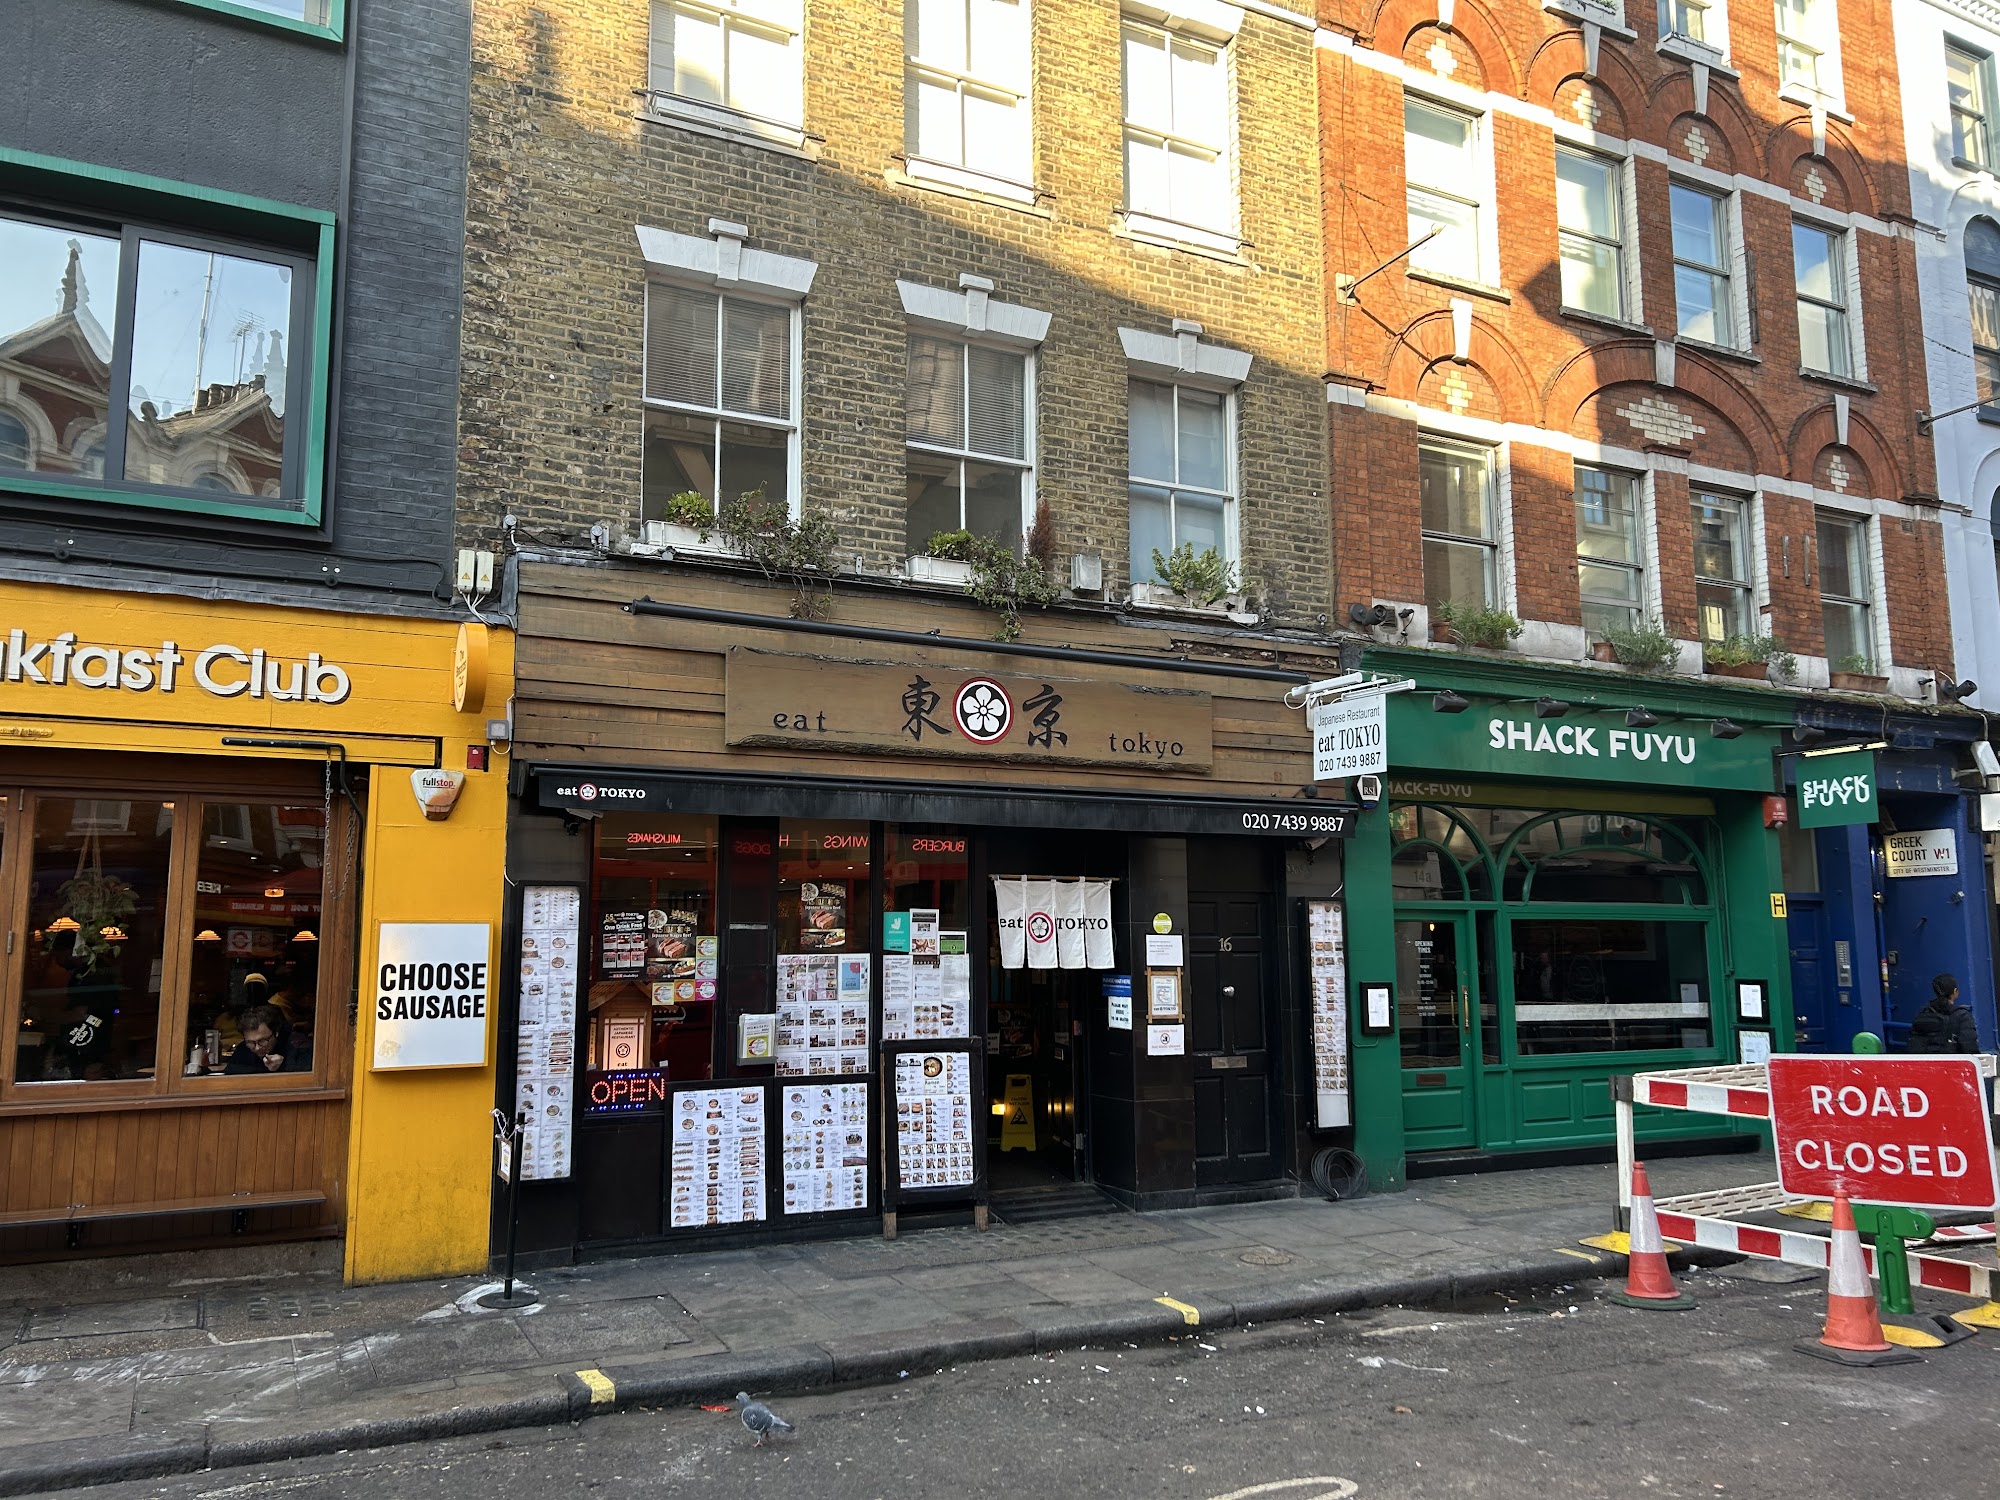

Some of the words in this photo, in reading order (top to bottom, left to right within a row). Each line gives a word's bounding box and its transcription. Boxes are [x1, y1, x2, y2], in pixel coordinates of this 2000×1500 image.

[194, 644, 351, 704] Club
[901, 674, 952, 742] 東
[1022, 683, 1069, 749] 京
[1317, 712, 1346, 728] Japanese
[1346, 705, 1381, 721] Restaurant
[772, 709, 827, 733] eat
[1108, 731, 1184, 760] tokyo
[1318, 731, 1335, 753] eat
[1338, 723, 1381, 751] TOKYO
[1488, 718, 1599, 757] SHACK
[1608, 729, 1696, 765] FUYU
[1319, 758, 1334, 772] 020
[1336, 755, 1357, 769] 7439
[1359, 751, 1381, 767] 9887
[556, 785, 578, 796] eat
[598, 786, 646, 799] TOKYO
[1388, 780, 1472, 798] HACK-FUYU
[1802, 774, 1868, 796] SHACK
[1803, 784, 1871, 808] FUYU
[1242, 812, 1270, 829] 020
[1271, 813, 1308, 831] 7439
[1310, 815, 1344, 832] 9887
[1890, 836, 1923, 849] GREEK
[1891, 848, 1928, 862] COURT
[1934, 847, 1950, 860] W1
[1772, 895, 1785, 915] H
[1000, 917, 1024, 929] eat
[1057, 917, 1109, 930] TOKYO
[1218, 936, 1233, 952] 16
[380, 962, 487, 992] CHOOSE
[377, 994, 485, 1021] SAUSAGE
[591, 1078, 665, 1104] OPEN
[1810, 1084, 1931, 1119] ROAD
[1794, 1138, 1969, 1178] CLOSED
